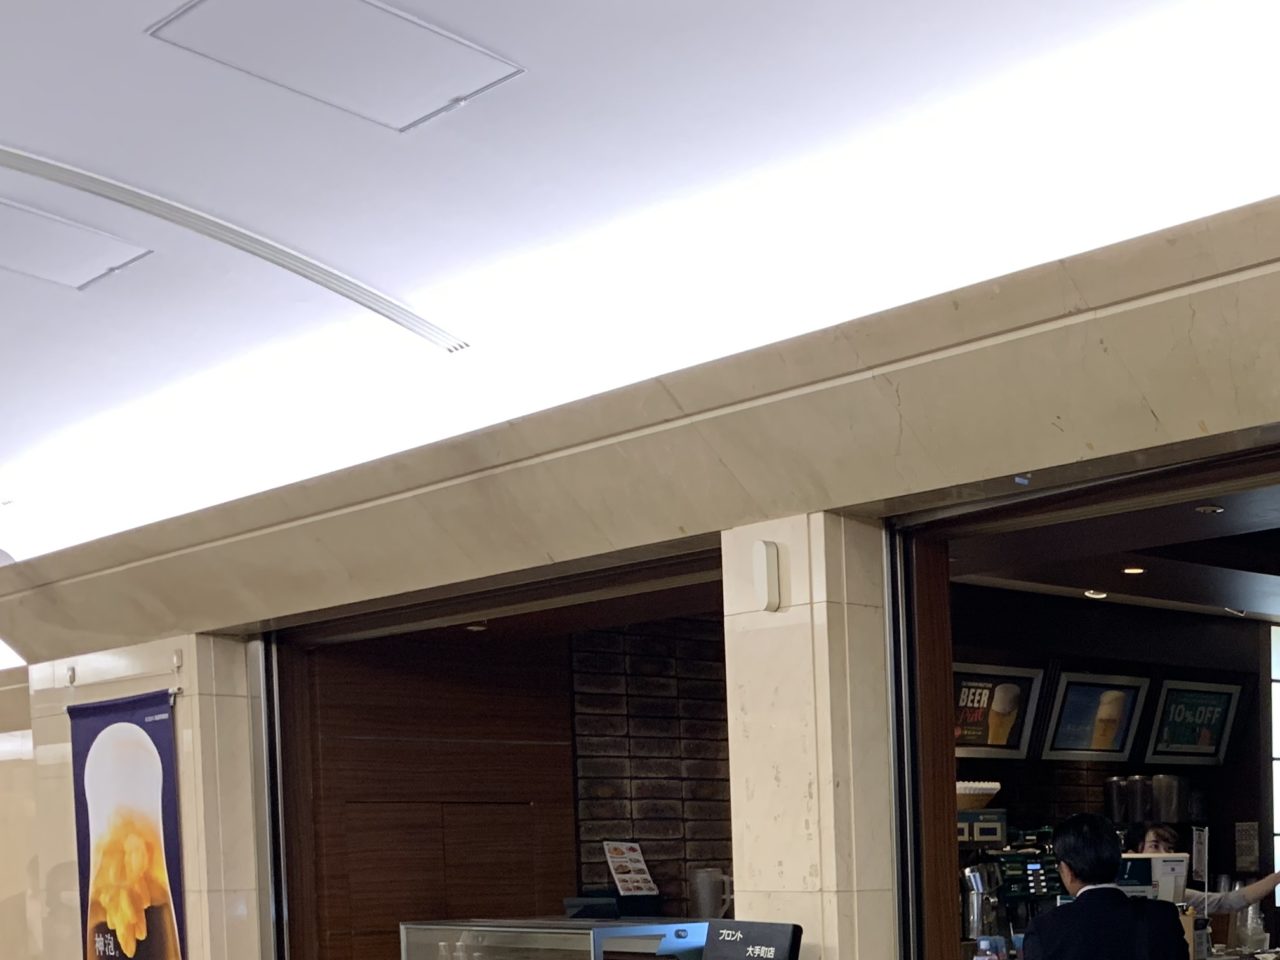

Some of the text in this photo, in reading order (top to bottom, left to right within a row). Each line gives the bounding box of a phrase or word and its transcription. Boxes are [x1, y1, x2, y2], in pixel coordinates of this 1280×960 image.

[959, 688, 989, 708] BEER
[719, 929, 744, 942] プロント
[745, 945, 776, 960] 大手町店
